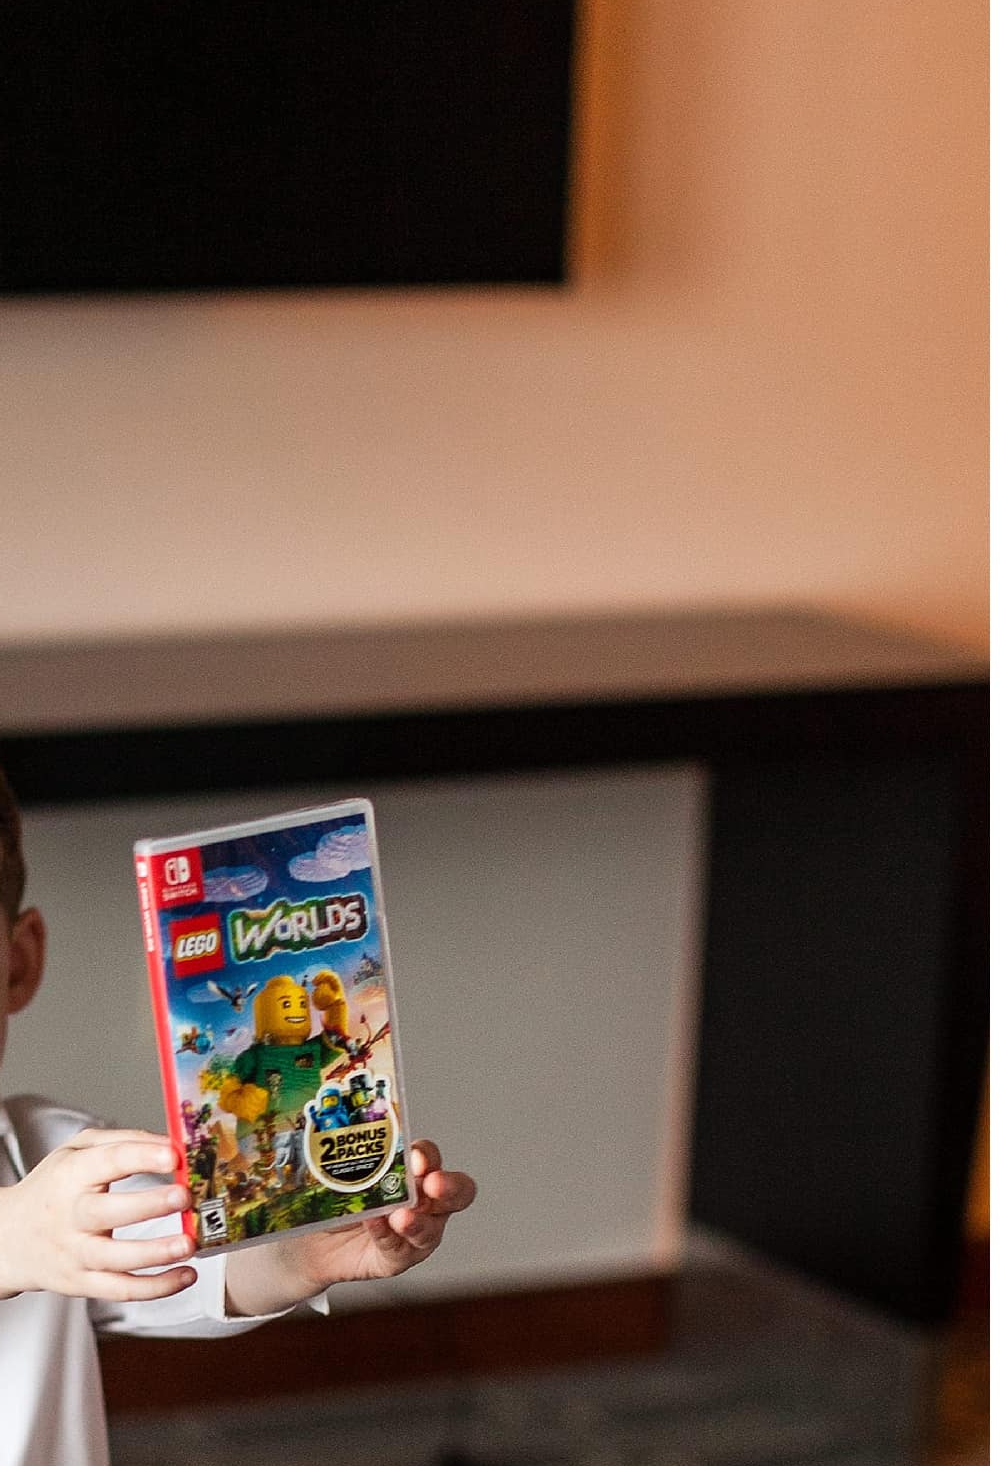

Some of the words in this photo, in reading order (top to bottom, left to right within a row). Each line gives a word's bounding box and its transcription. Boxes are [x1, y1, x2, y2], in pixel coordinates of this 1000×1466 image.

[176, 931, 218, 959] LEGO
[235, 901, 362, 955] WORLDS
[319, 1136, 337, 1163] 2
[336, 1127, 387, 1147] BONUS
[337, 1141, 384, 1159] PACKS
[205, 1210, 224, 1233] E
